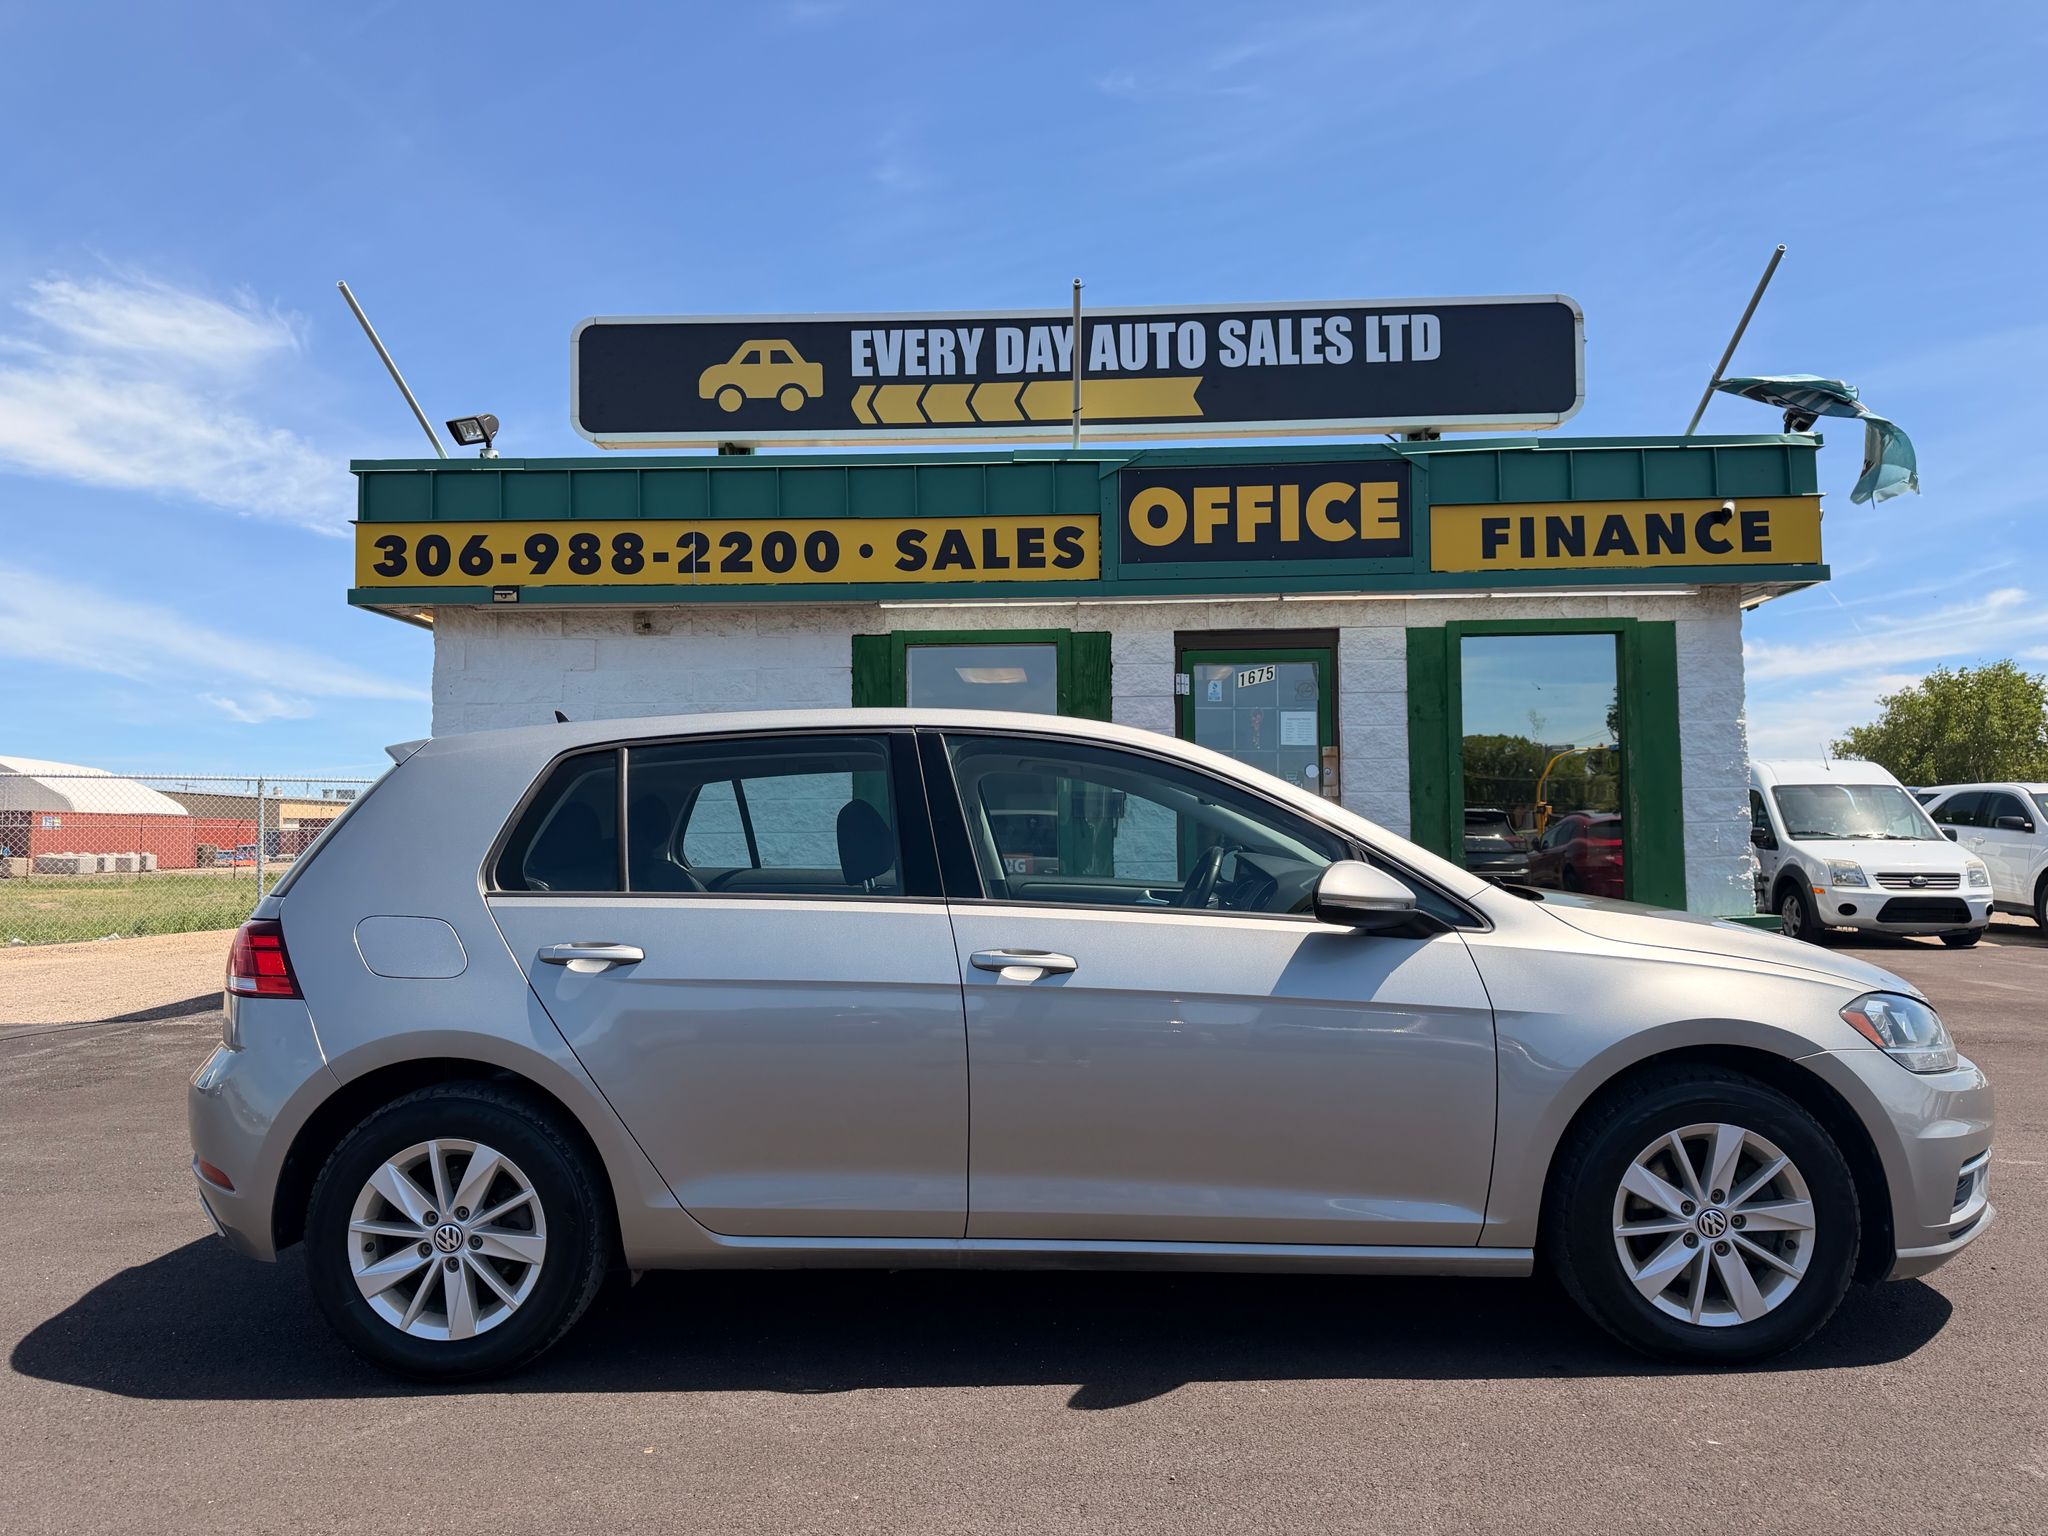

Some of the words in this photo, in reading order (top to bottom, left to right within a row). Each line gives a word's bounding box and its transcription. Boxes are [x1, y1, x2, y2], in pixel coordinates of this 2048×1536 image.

[850, 328, 984, 377] EVERY
[995, 326, 1075, 374] DAY
[1088, 321, 1207, 372] AUTO
[1218, 316, 1354, 368] SALES
[1365, 314, 1441, 363] LTD
[1128, 482, 1400, 546] OFFICE
[1481, 510, 1772, 560] FINANCE
[372, 531, 840, 578] 306-988-2200
[894, 526, 1085, 572] SALES
[1239, 666, 1274, 687] 1675
